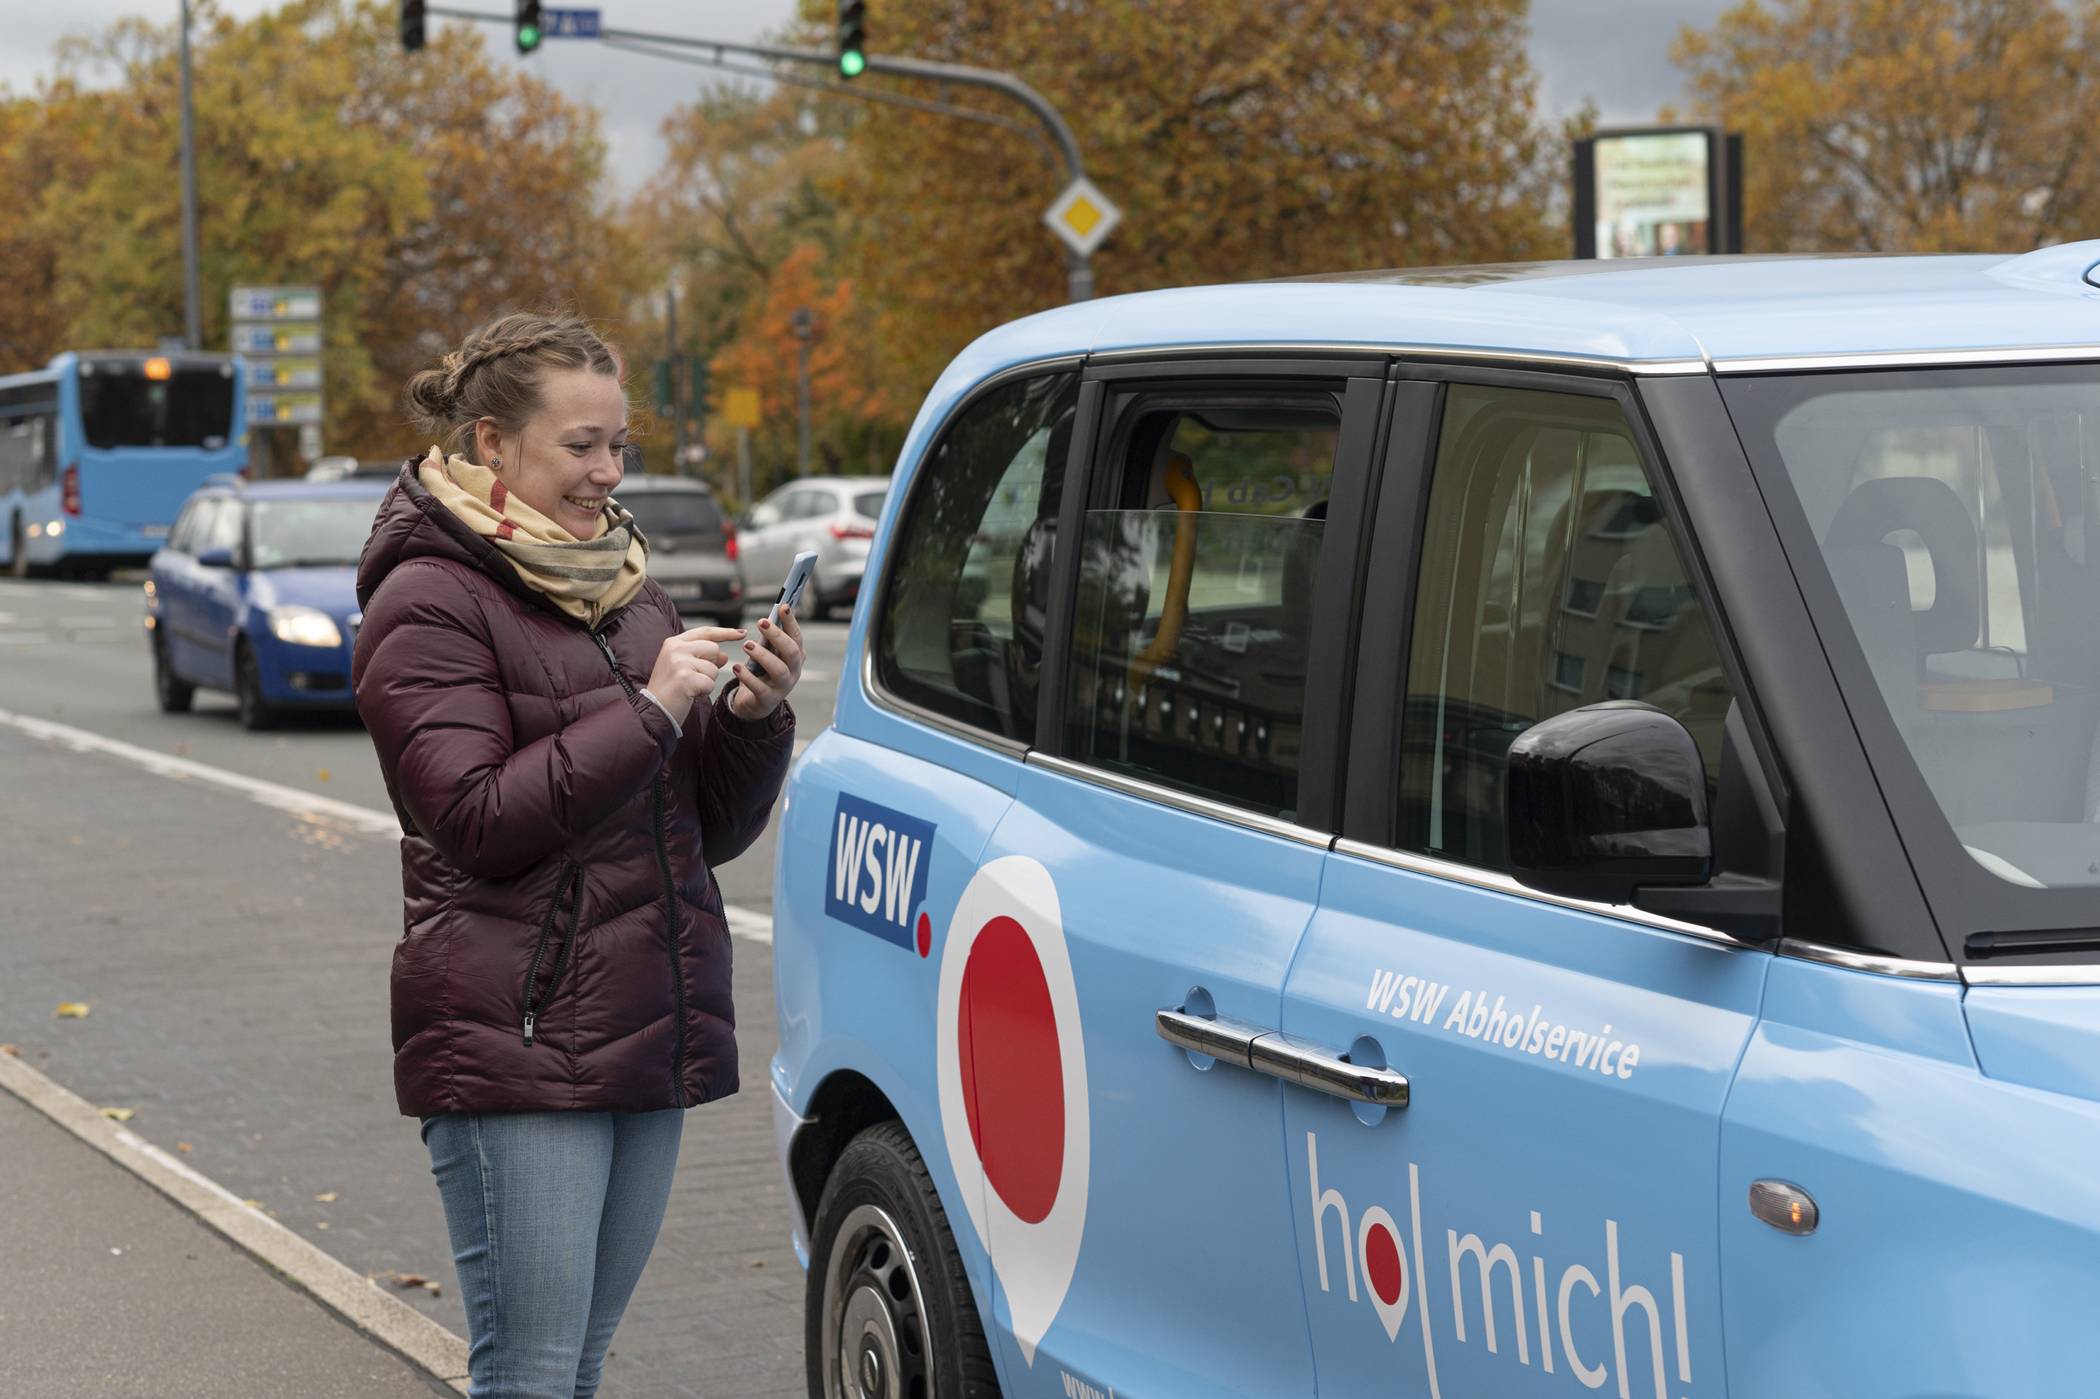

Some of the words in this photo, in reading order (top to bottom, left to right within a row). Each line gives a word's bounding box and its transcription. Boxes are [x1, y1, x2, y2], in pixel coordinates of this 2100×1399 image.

[1366, 969, 1449, 1025] WSW
[1443, 990, 1641, 1080] Abholservice
[1447, 1209, 1692, 1399] mich!
